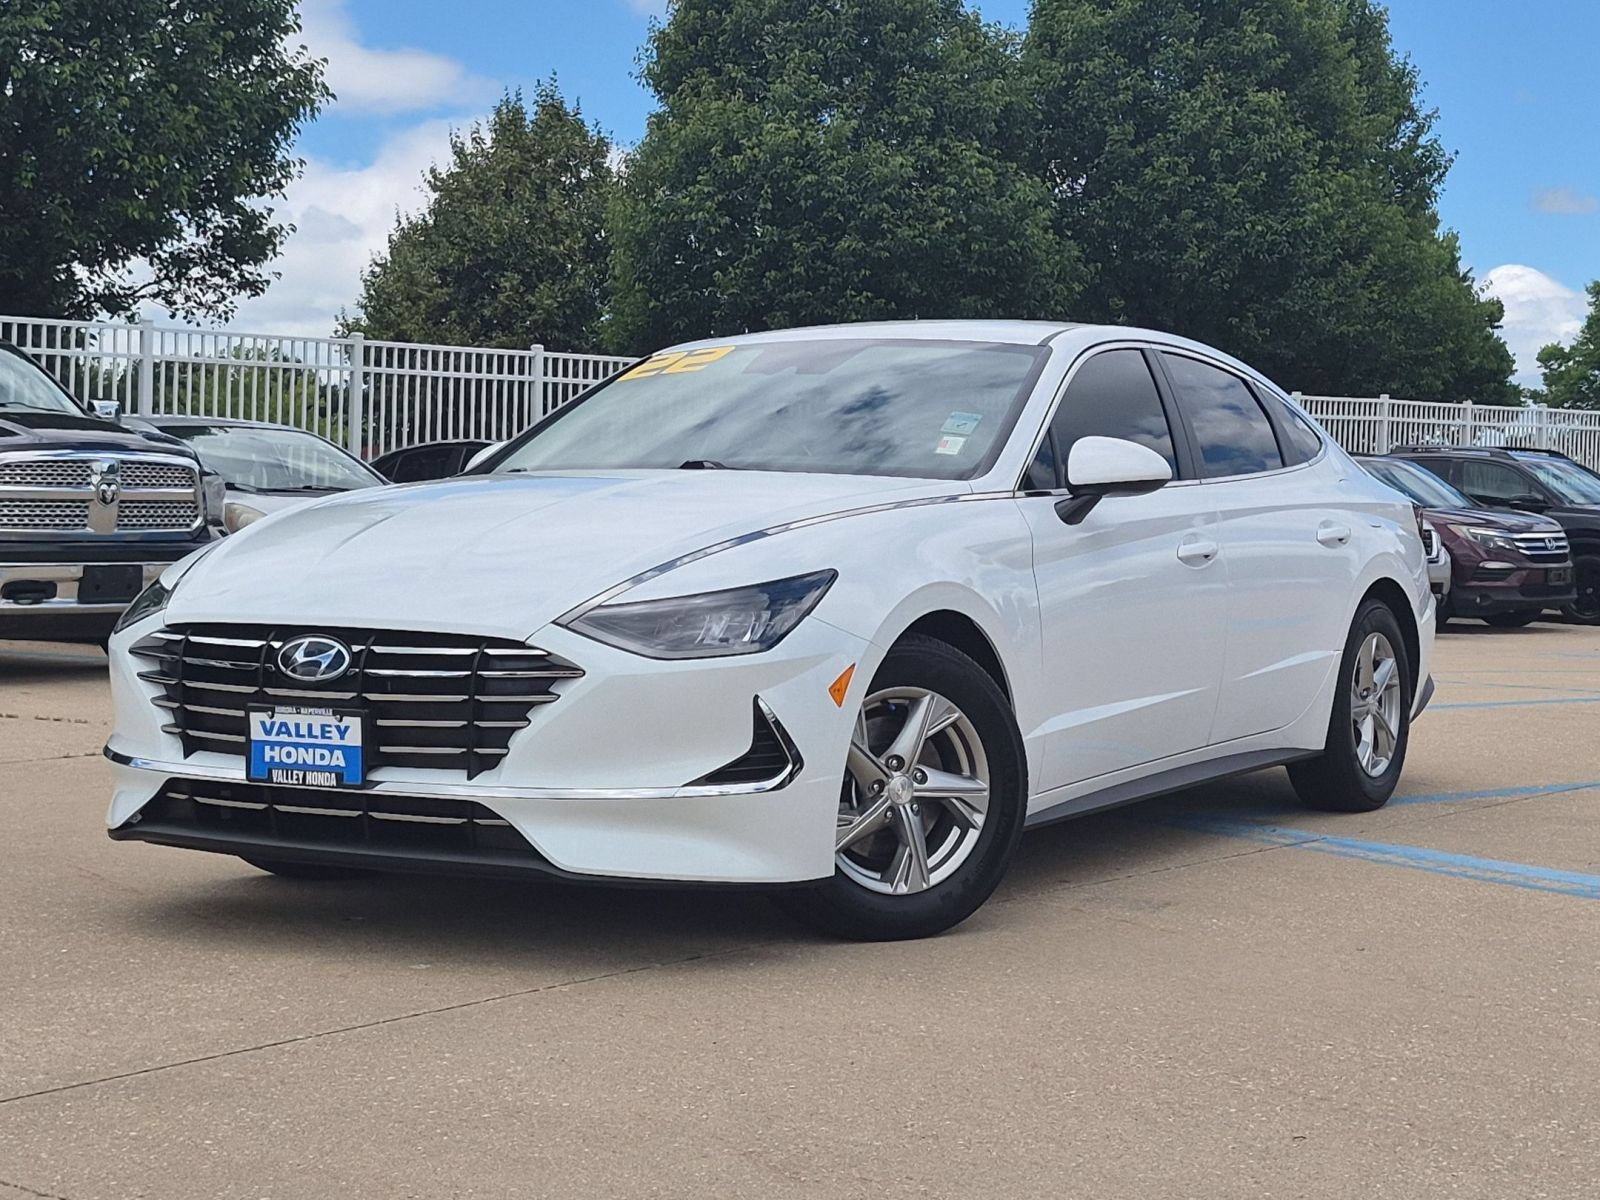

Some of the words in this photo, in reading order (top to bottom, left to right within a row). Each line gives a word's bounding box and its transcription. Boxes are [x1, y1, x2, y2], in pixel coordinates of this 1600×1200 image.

[616, 346, 735, 381] 22
[259, 720, 350, 741] VALLEY
[264, 745, 346, 767] HONDA
[272, 769, 303, 784] VALLEY
[305, 772, 337, 787] HONDA
